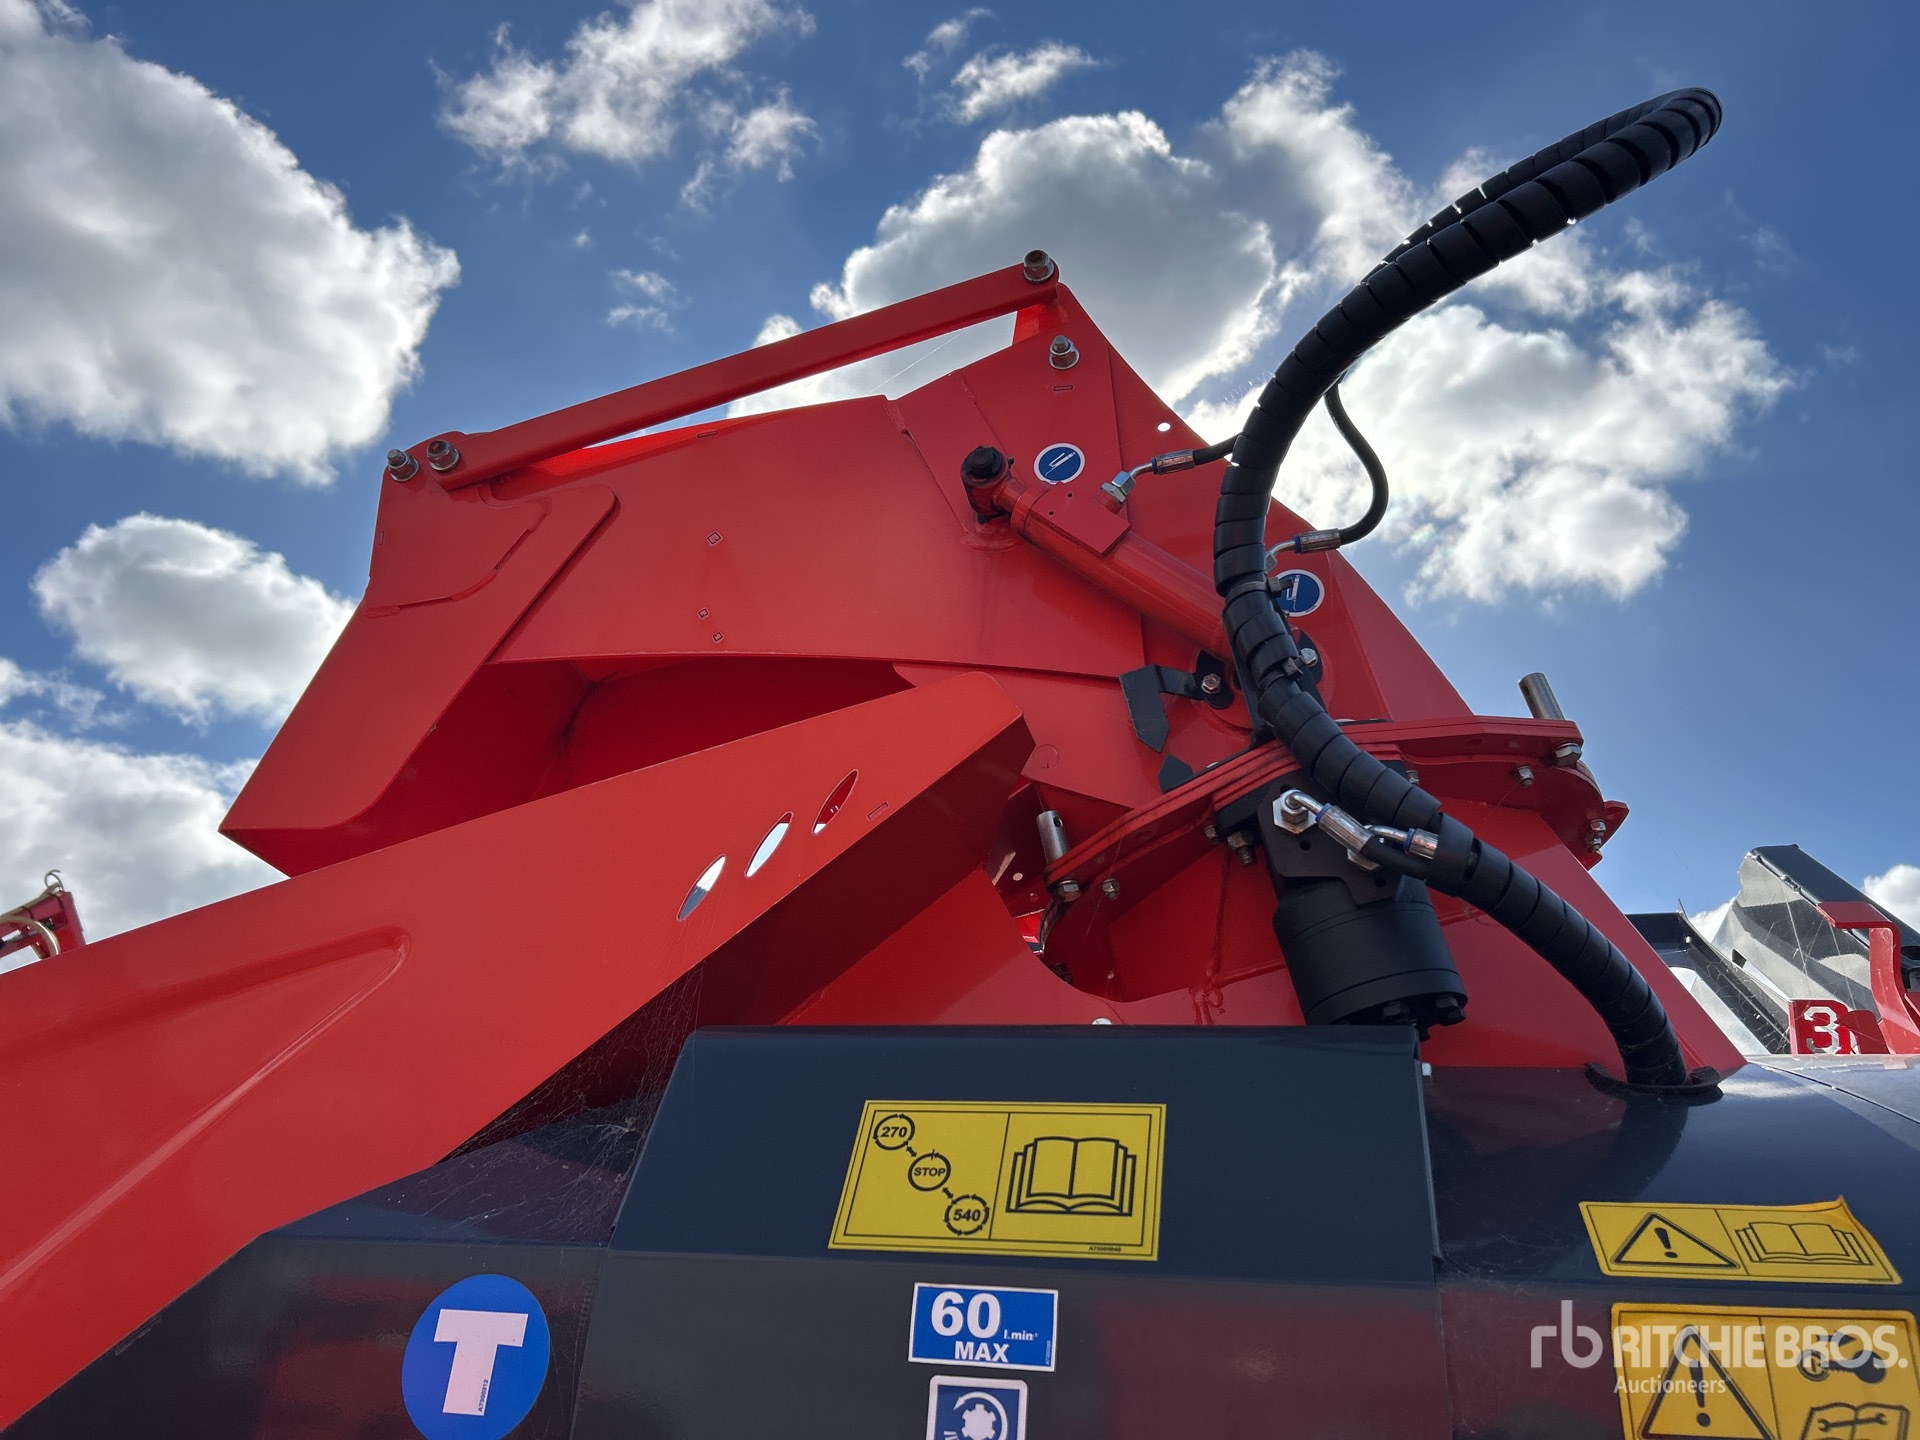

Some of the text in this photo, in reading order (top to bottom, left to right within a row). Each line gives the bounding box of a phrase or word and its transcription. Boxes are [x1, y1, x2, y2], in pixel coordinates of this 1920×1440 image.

[880, 1126, 907, 1138] 270
[913, 1166, 946, 1178] STOP
[953, 1208, 981, 1222] 540
[931, 1291, 1000, 1338] 60
[955, 1341, 1009, 1363] MAX
[434, 1309, 528, 1416] T
